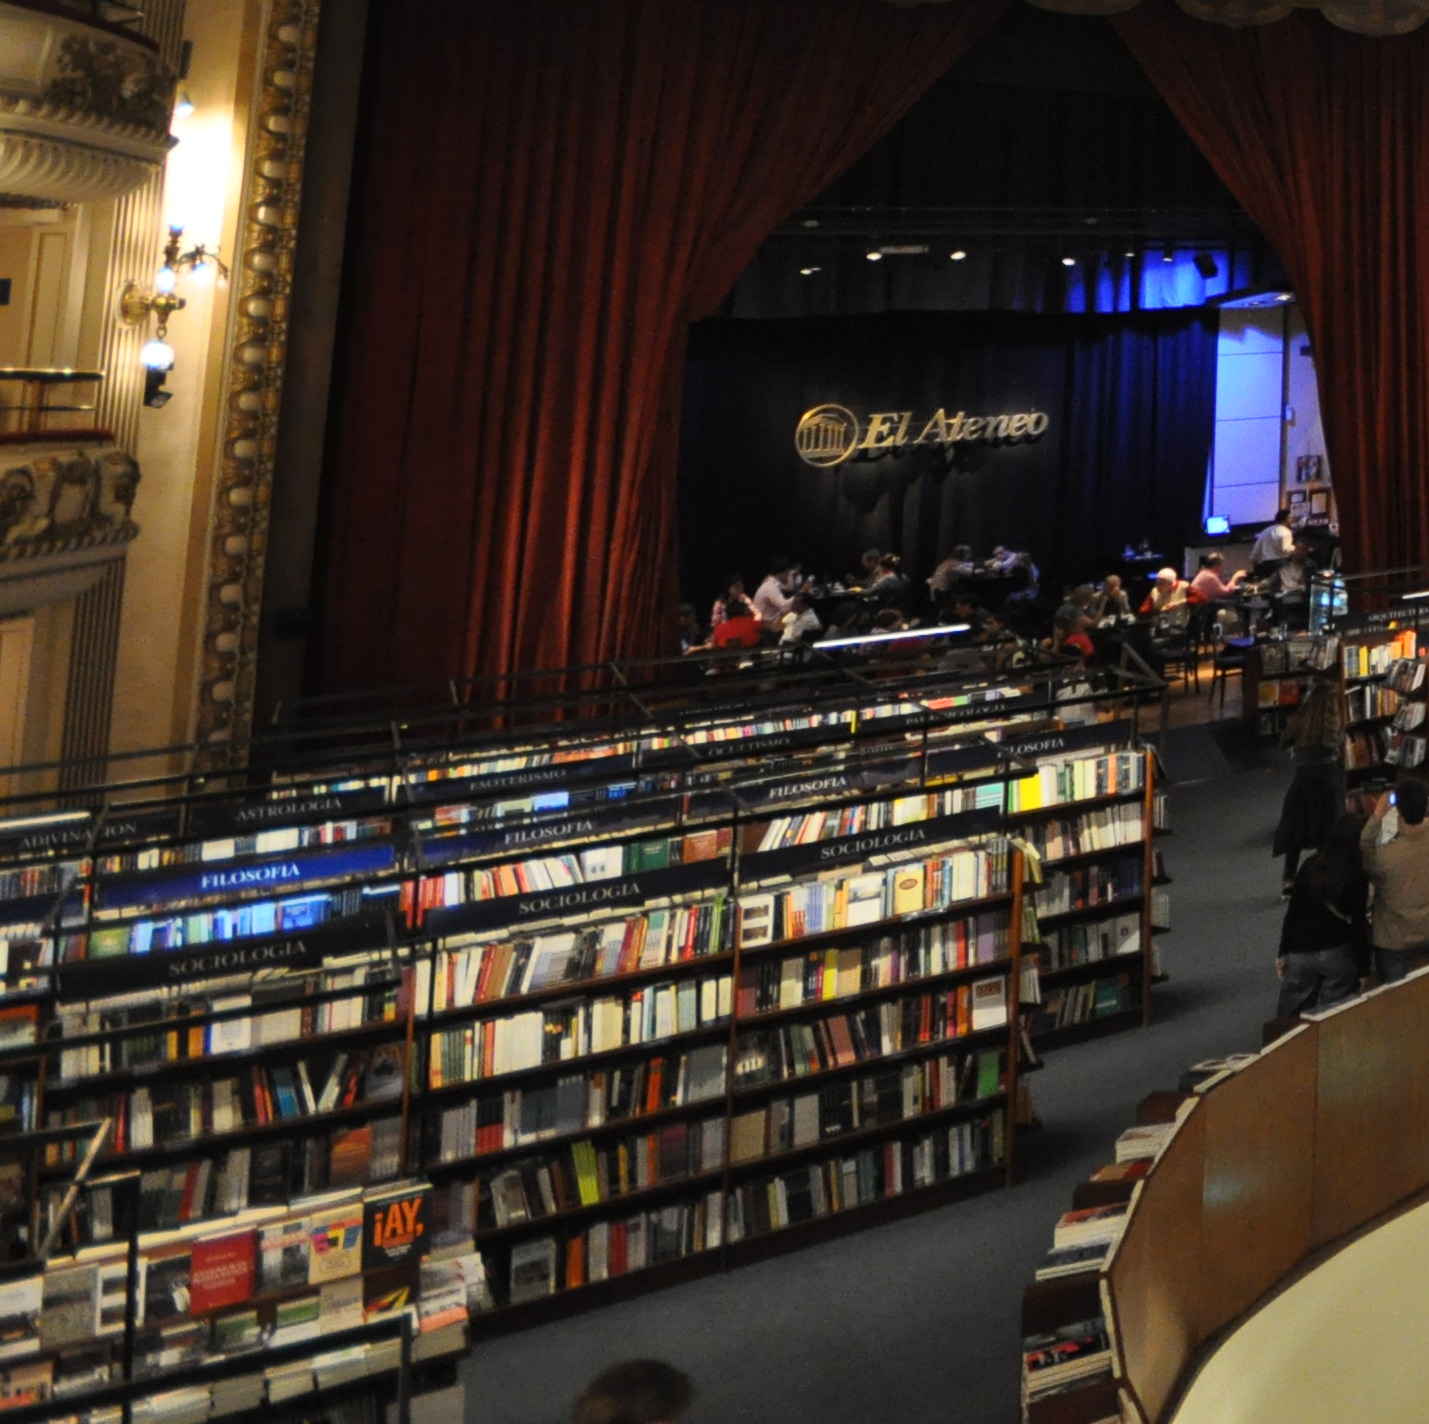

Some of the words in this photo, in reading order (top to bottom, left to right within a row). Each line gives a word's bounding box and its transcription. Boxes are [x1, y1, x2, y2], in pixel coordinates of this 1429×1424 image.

[858, 411, 913, 449] El
[913, 407, 1049, 444] Ateneo
[469, 769, 567, 791] ESOTERISMO
[769, 776, 847, 799] FILOSOFIA
[236, 797, 342, 822] ASTROLOGIA
[22, 822, 137, 849] ADIVINAION
[504, 820, 593, 845] FILOSOFIA
[821, 828, 925, 860] SOCIOLOGIA
[200, 863, 300, 889] FILOSOFIA
[519, 882, 641, 915] SOCIOLOGIA
[169, 940, 306, 976] SOCIOLOGIA
